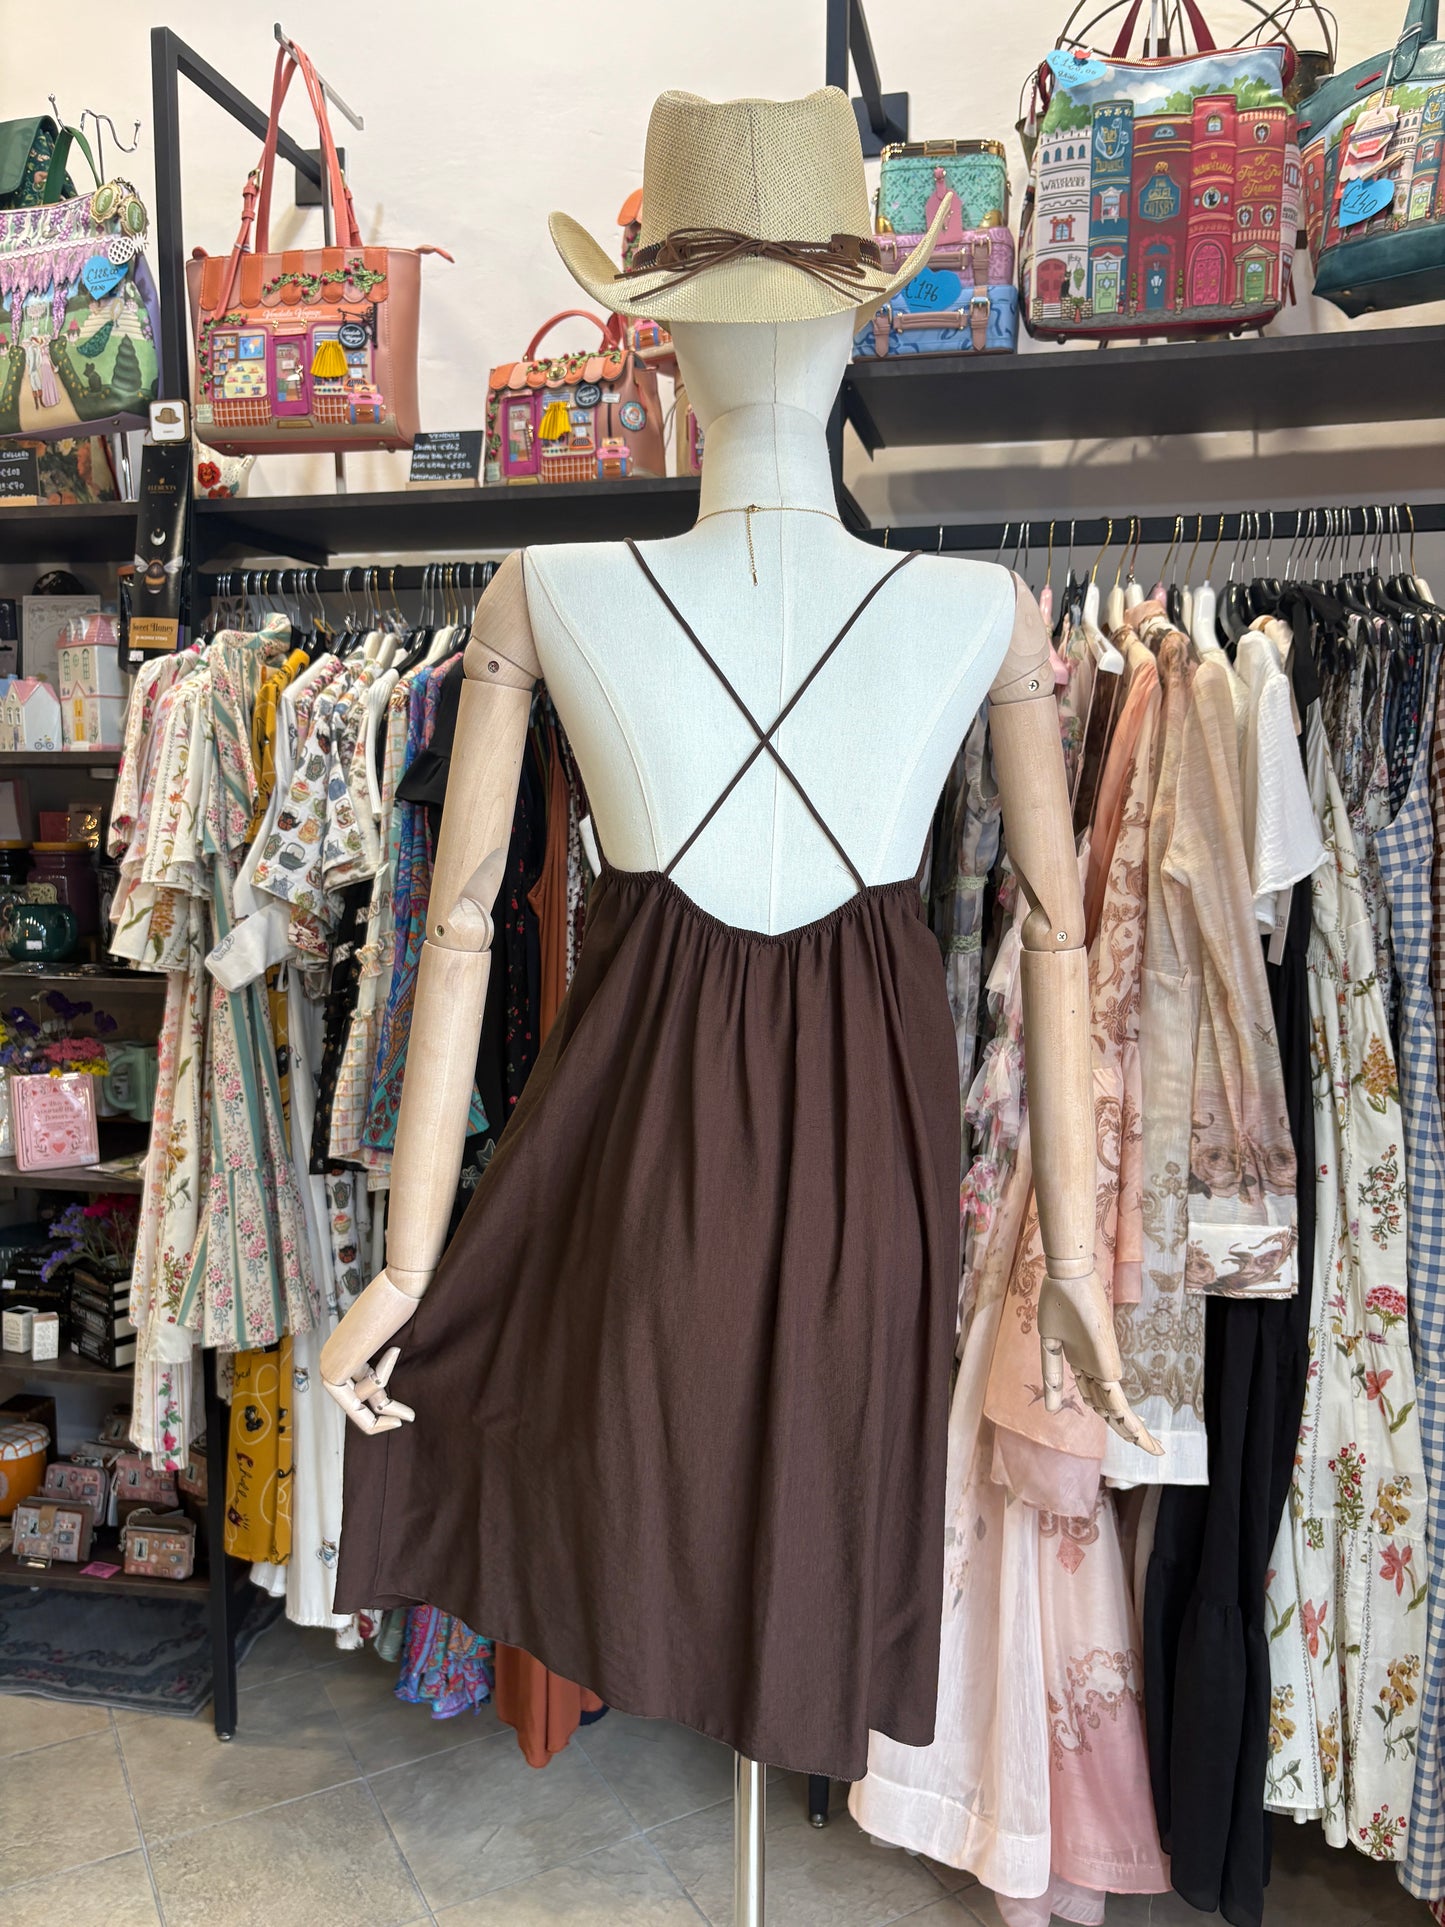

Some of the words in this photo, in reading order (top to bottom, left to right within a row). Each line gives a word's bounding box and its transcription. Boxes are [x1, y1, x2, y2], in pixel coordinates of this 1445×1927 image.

[1342, 185, 1378, 214] €140
[132, 623, 149, 631] Sweet
[150, 622, 174, 633] Honey
